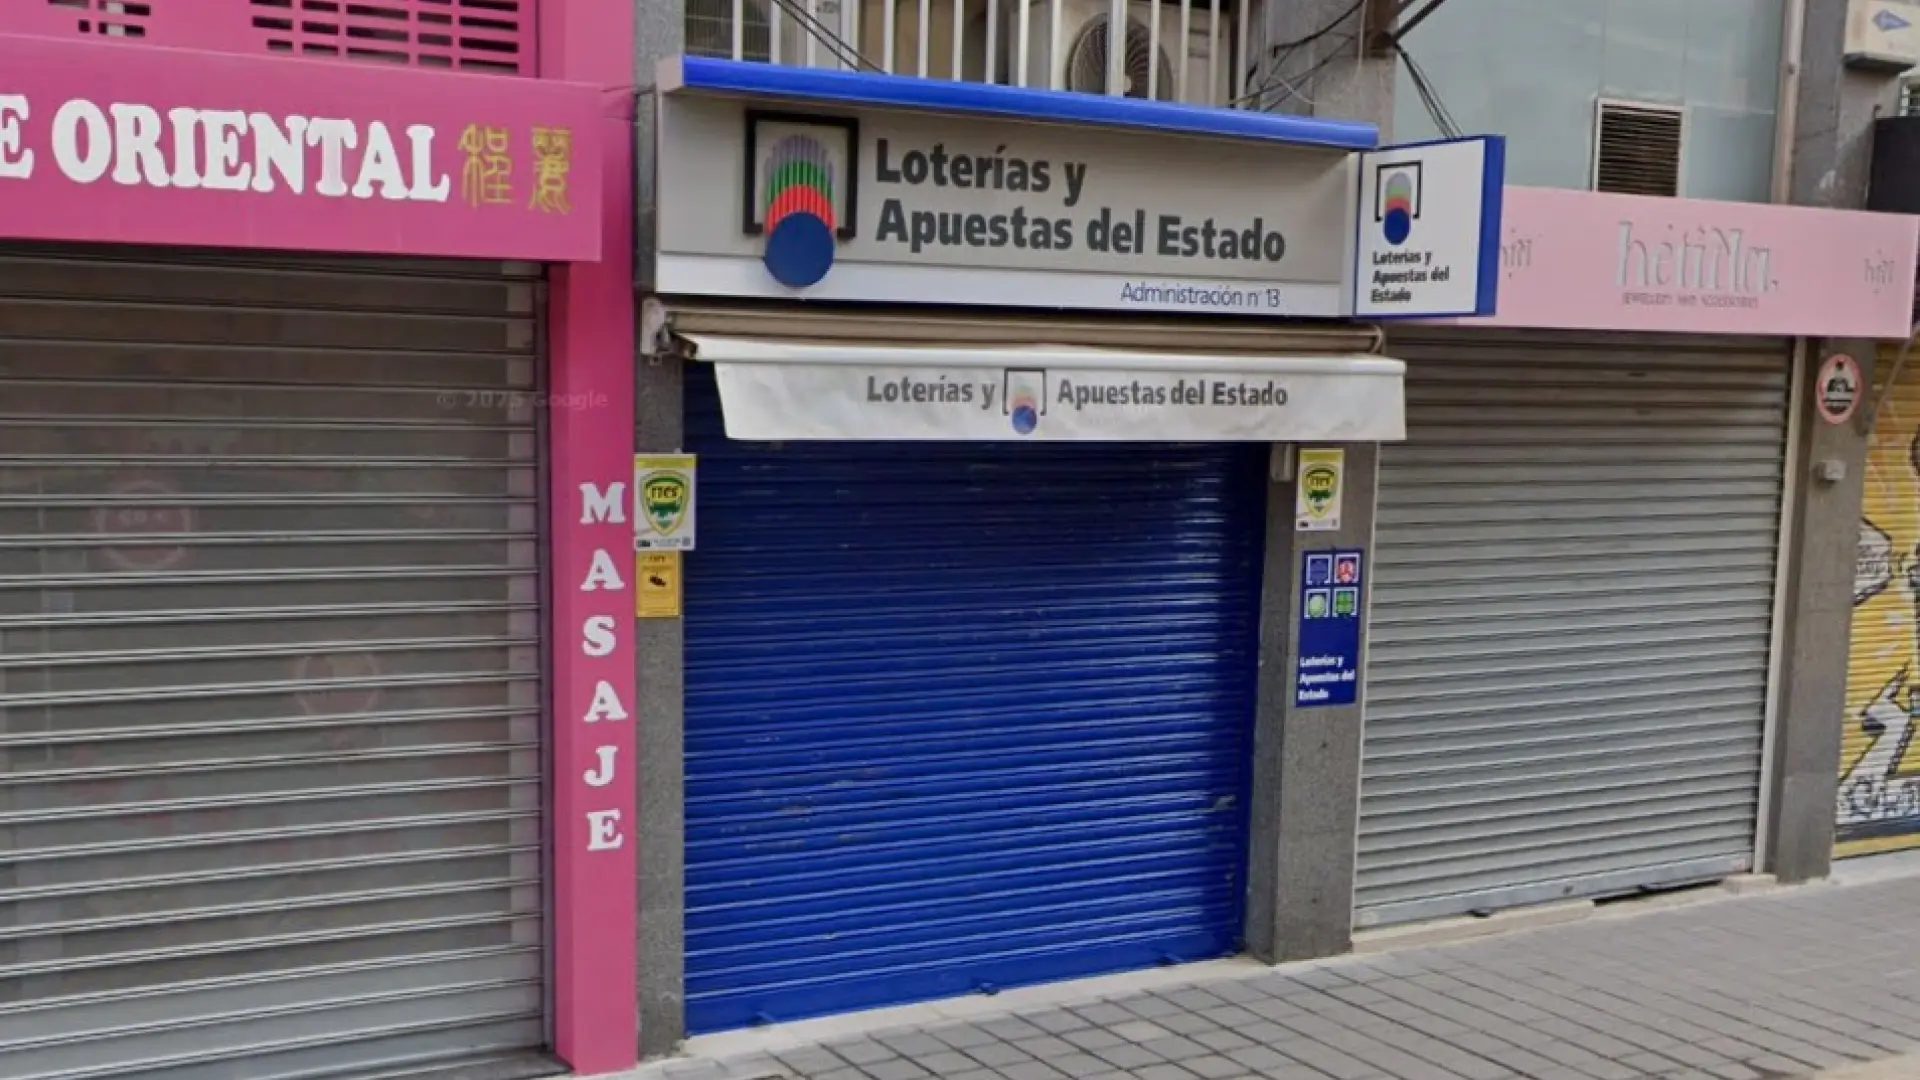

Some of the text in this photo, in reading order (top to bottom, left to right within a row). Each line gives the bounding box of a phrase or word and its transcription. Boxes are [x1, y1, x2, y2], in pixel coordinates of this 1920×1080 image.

[52, 98, 450, 202] ORIENTAL
[876, 137, 1086, 207] Loterías y
[876, 198, 1285, 262] Apuestas del Estado
[1120, 281, 1242, 306] Administración
[1372, 265, 1450, 287] Apuestas del
[1370, 286, 1412, 304] Estado
[867, 374, 996, 409] Loterías y
[1057, 379, 1288, 410] Apuestas del Estado
[579, 481, 628, 851] MASAJE
